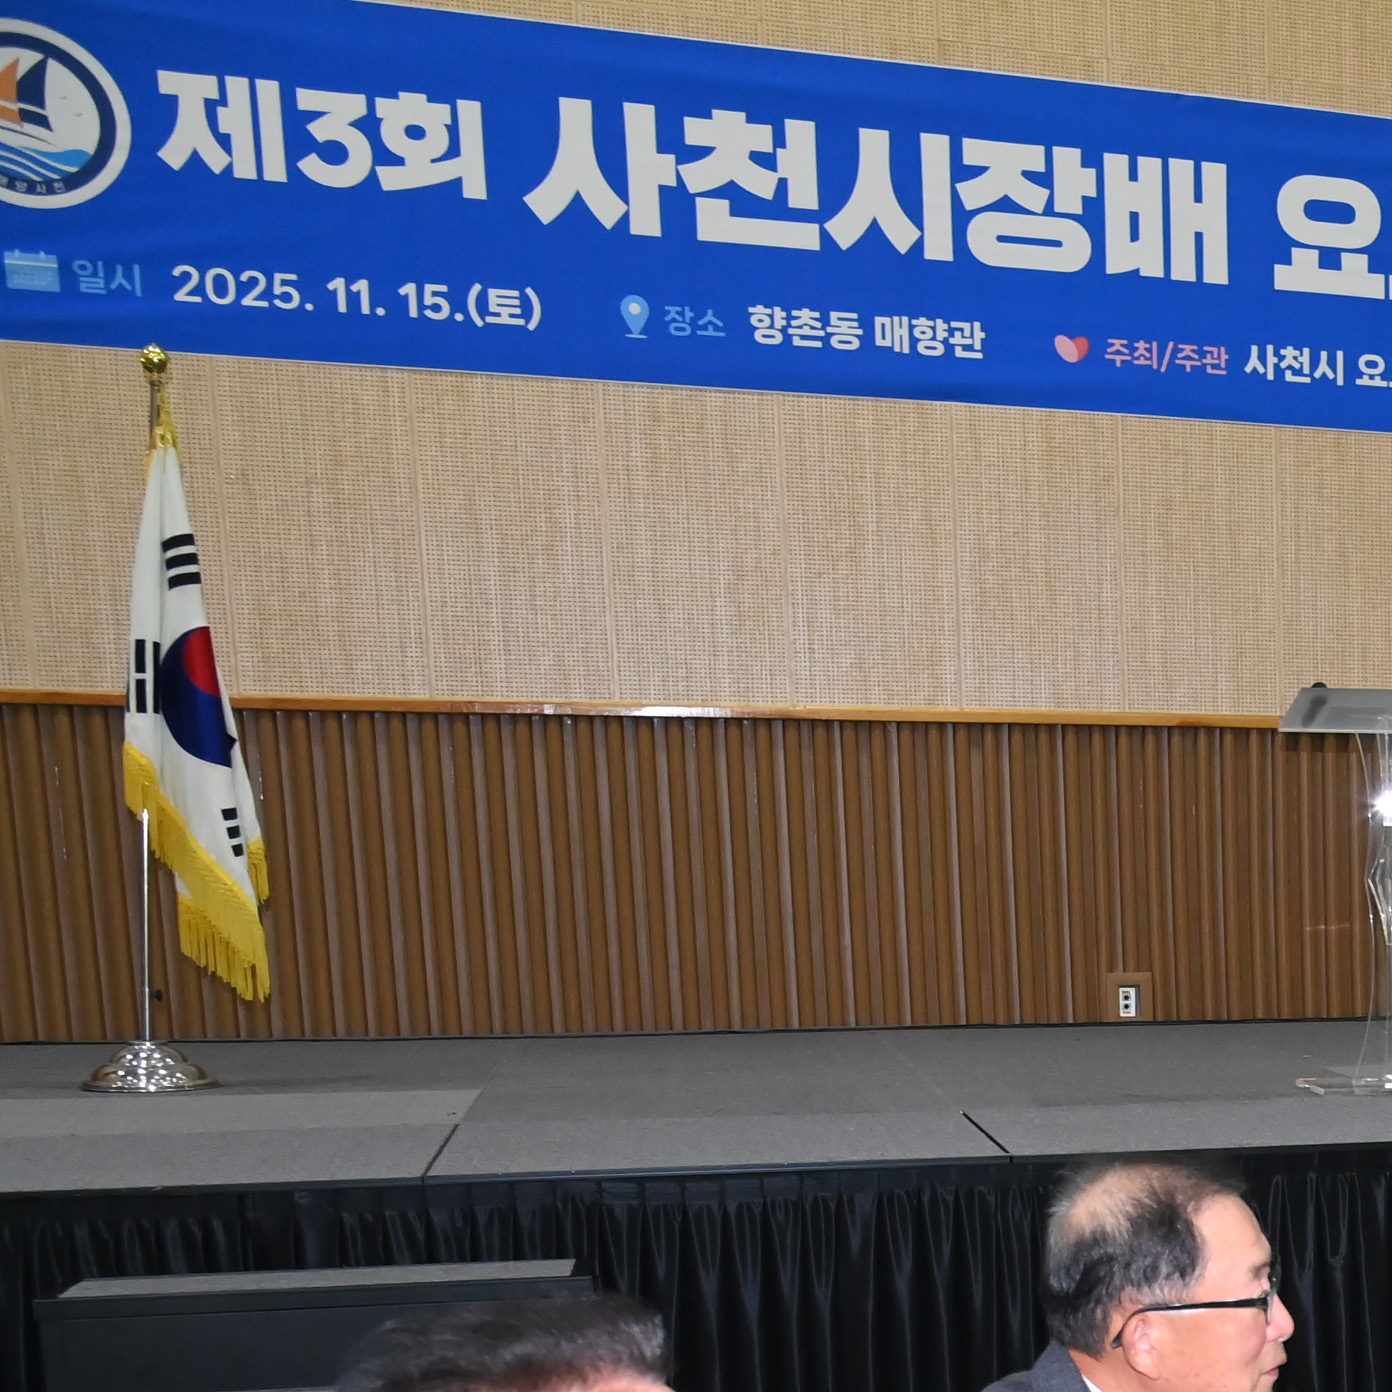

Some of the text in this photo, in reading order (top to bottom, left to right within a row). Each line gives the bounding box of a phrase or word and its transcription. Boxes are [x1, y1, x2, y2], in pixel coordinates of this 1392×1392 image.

[156, 69, 488, 201] 제3회
[522, 96, 1230, 286] 사천시장배
[71, 259, 542, 332] 일시 2025. 11. 15.(토)
[664, 304, 986, 361] 장소 향촌동 매향관
[1104, 336, 1229, 376] 주최/주관
[1244, 344, 1345, 387] 사천시
